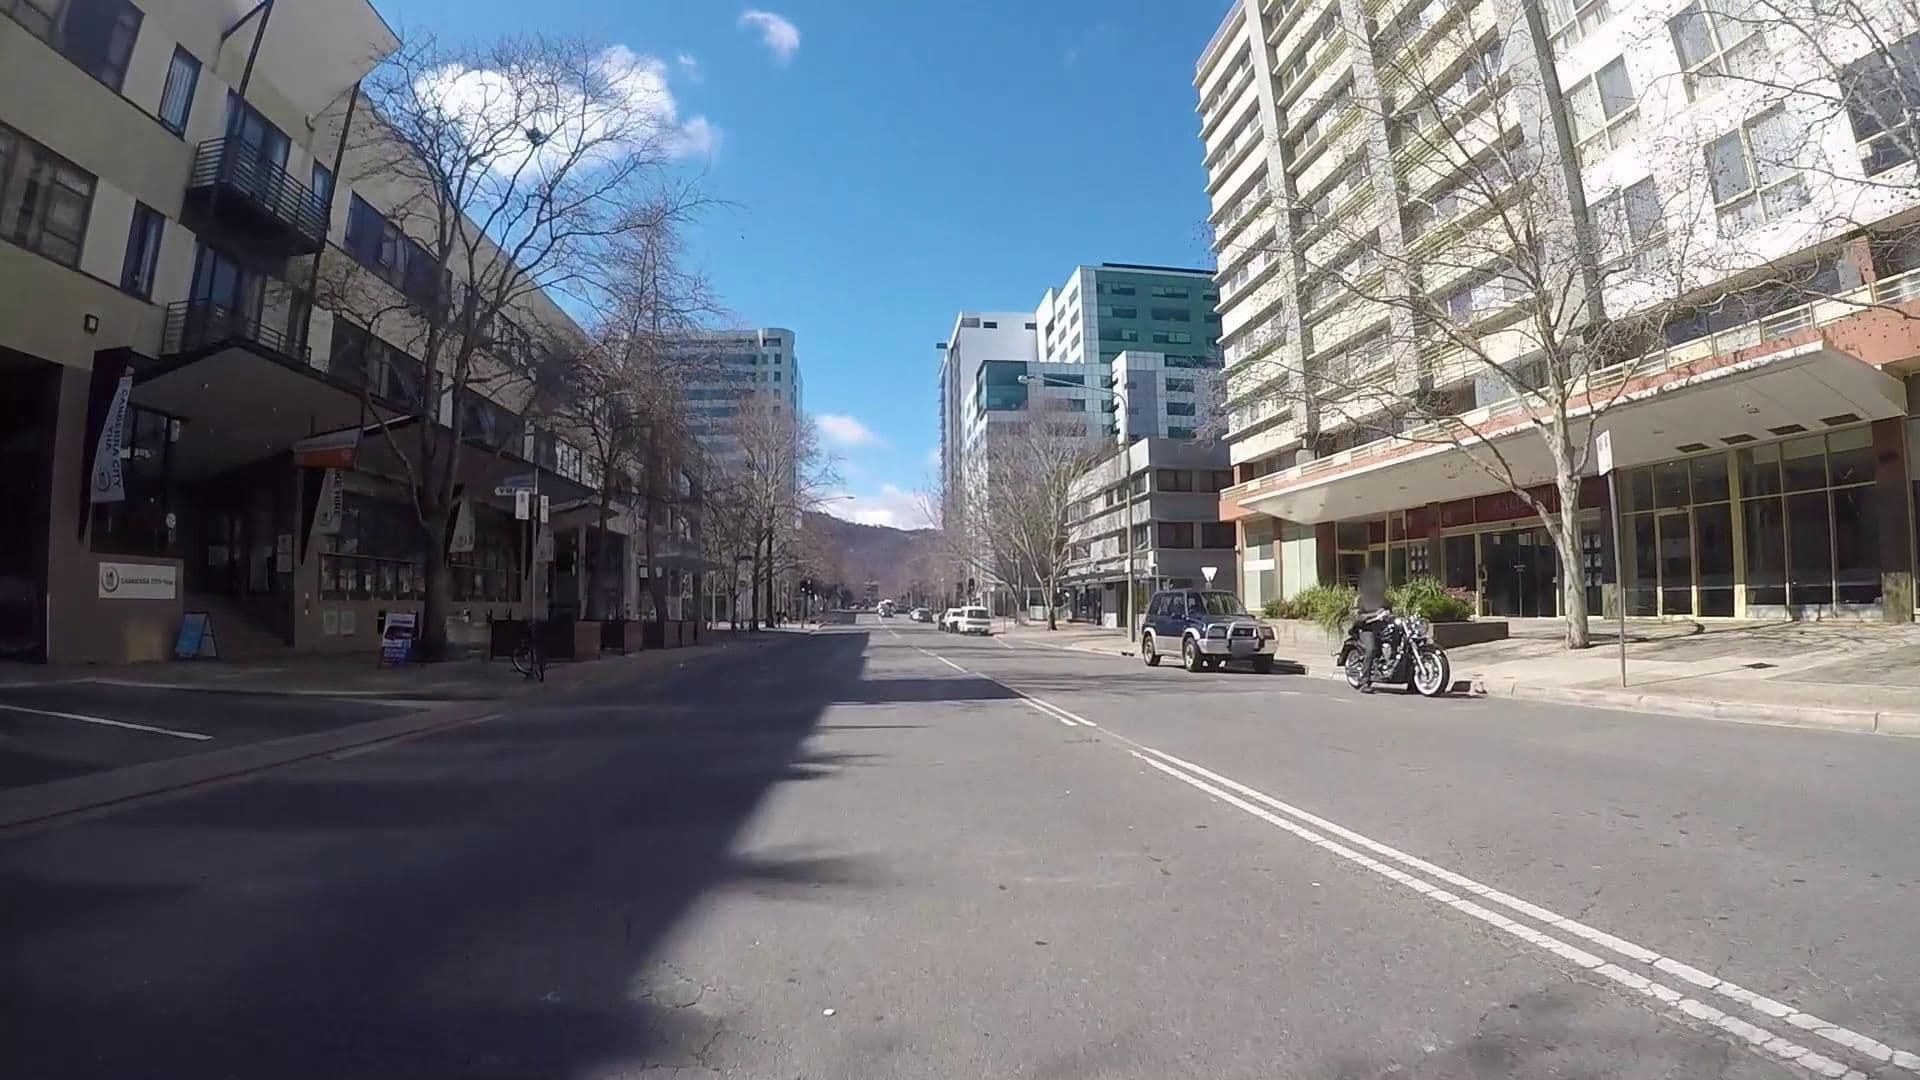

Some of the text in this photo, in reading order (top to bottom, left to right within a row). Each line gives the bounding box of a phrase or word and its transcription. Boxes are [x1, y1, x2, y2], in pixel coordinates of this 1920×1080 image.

[105, 426, 113, 451] YHA
[112, 389, 128, 489] CANBERRA CITY
